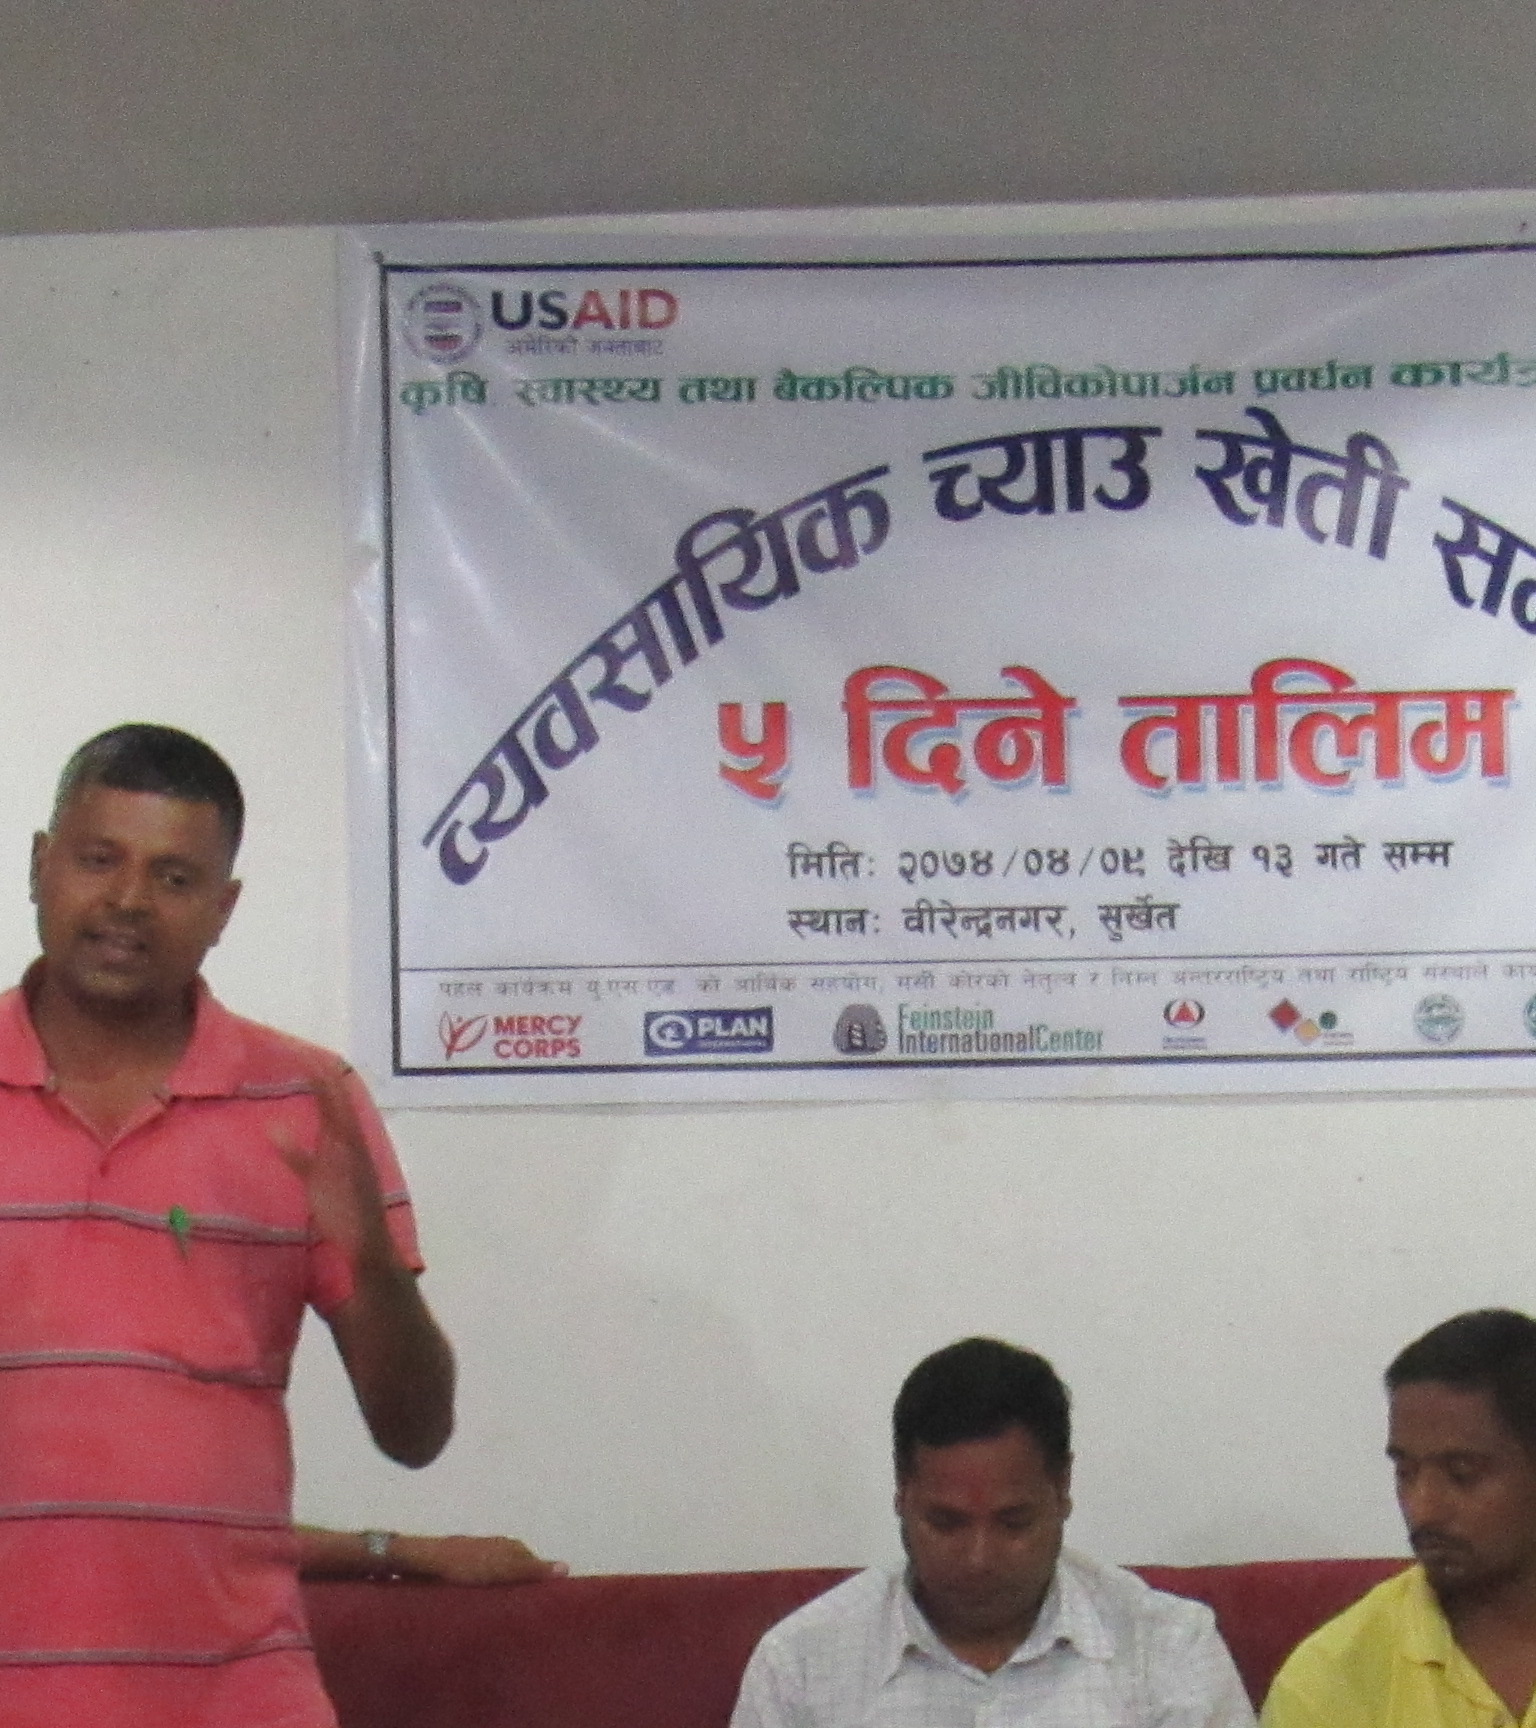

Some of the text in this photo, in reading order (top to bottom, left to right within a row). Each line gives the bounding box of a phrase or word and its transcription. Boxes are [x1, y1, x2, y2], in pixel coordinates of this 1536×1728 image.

[490, 288, 678, 332] USAID
[399, 369, 489, 415] कृषि
[514, 376, 664, 407] स्वास्थ्य
[678, 376, 757, 405] तथा
[971, 363, 1236, 401] जीविकोपार्जन
[421, 465, 892, 886] व्यवसायिक
[921, 424, 1164, 523] च्याउ
[1192, 405, 1410, 561] खेती
[841, 663, 1079, 796] दिने
[1116, 656, 1516, 798] तालिम
[1166, 835, 1234, 878] देखि
[1250, 843, 1294, 878] १३
[1314, 834, 1366, 871] गते
[1381, 841, 1455, 872] सम्म
[493, 1014, 582, 1035] MERCY
[697, 1016, 768, 1037] PLAN
[899, 1003, 994, 1031] Feinstein
[493, 1037, 582, 1058] CORPS
